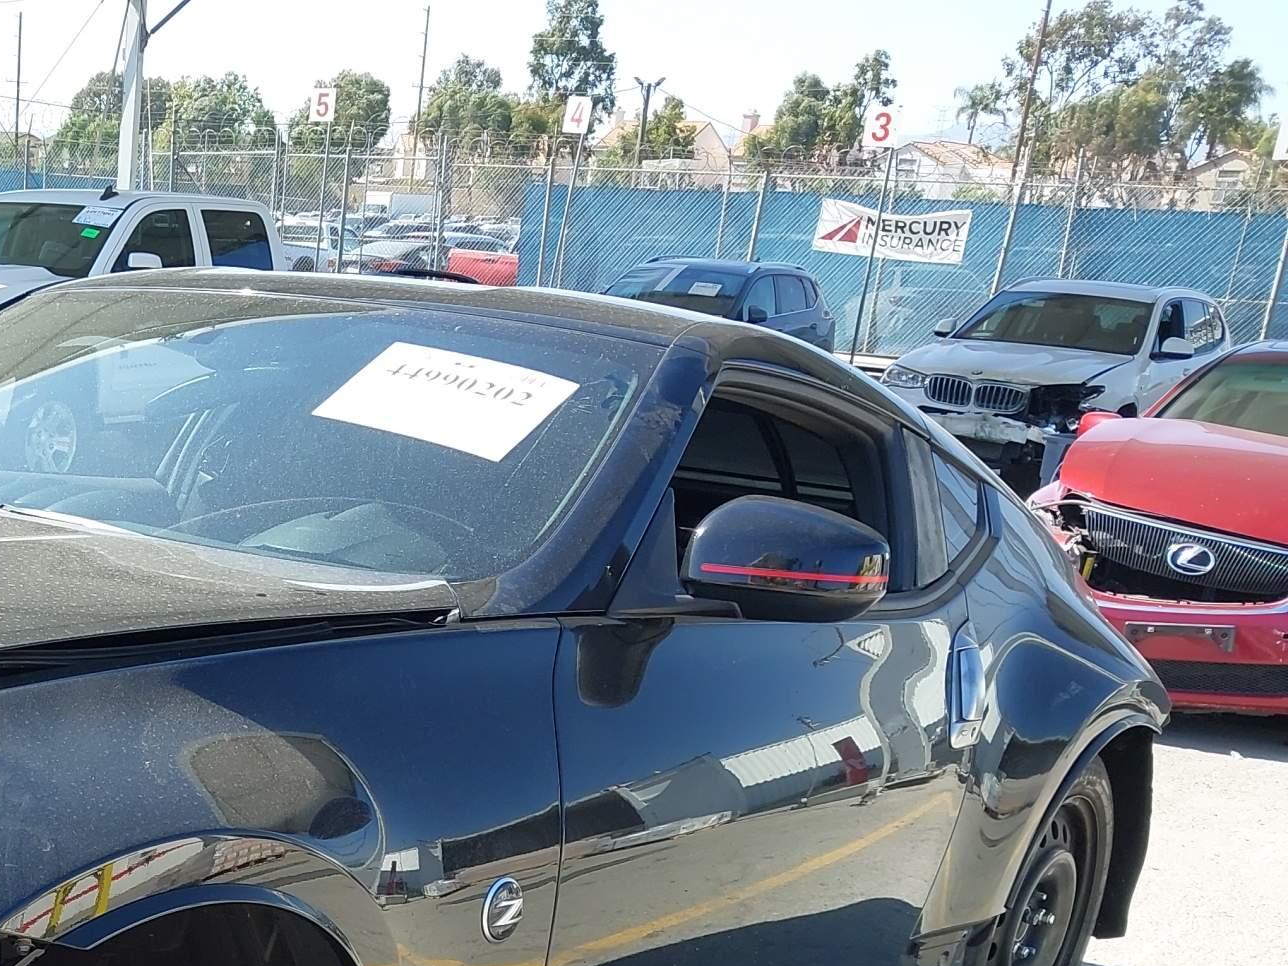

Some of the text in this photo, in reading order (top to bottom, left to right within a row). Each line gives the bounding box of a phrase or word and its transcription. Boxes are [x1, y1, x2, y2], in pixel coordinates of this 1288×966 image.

[316, 92, 330, 118] 5
[570, 101, 583, 128] 4
[871, 112, 892, 142] 3
[861, 232, 964, 253] INSURANCE
